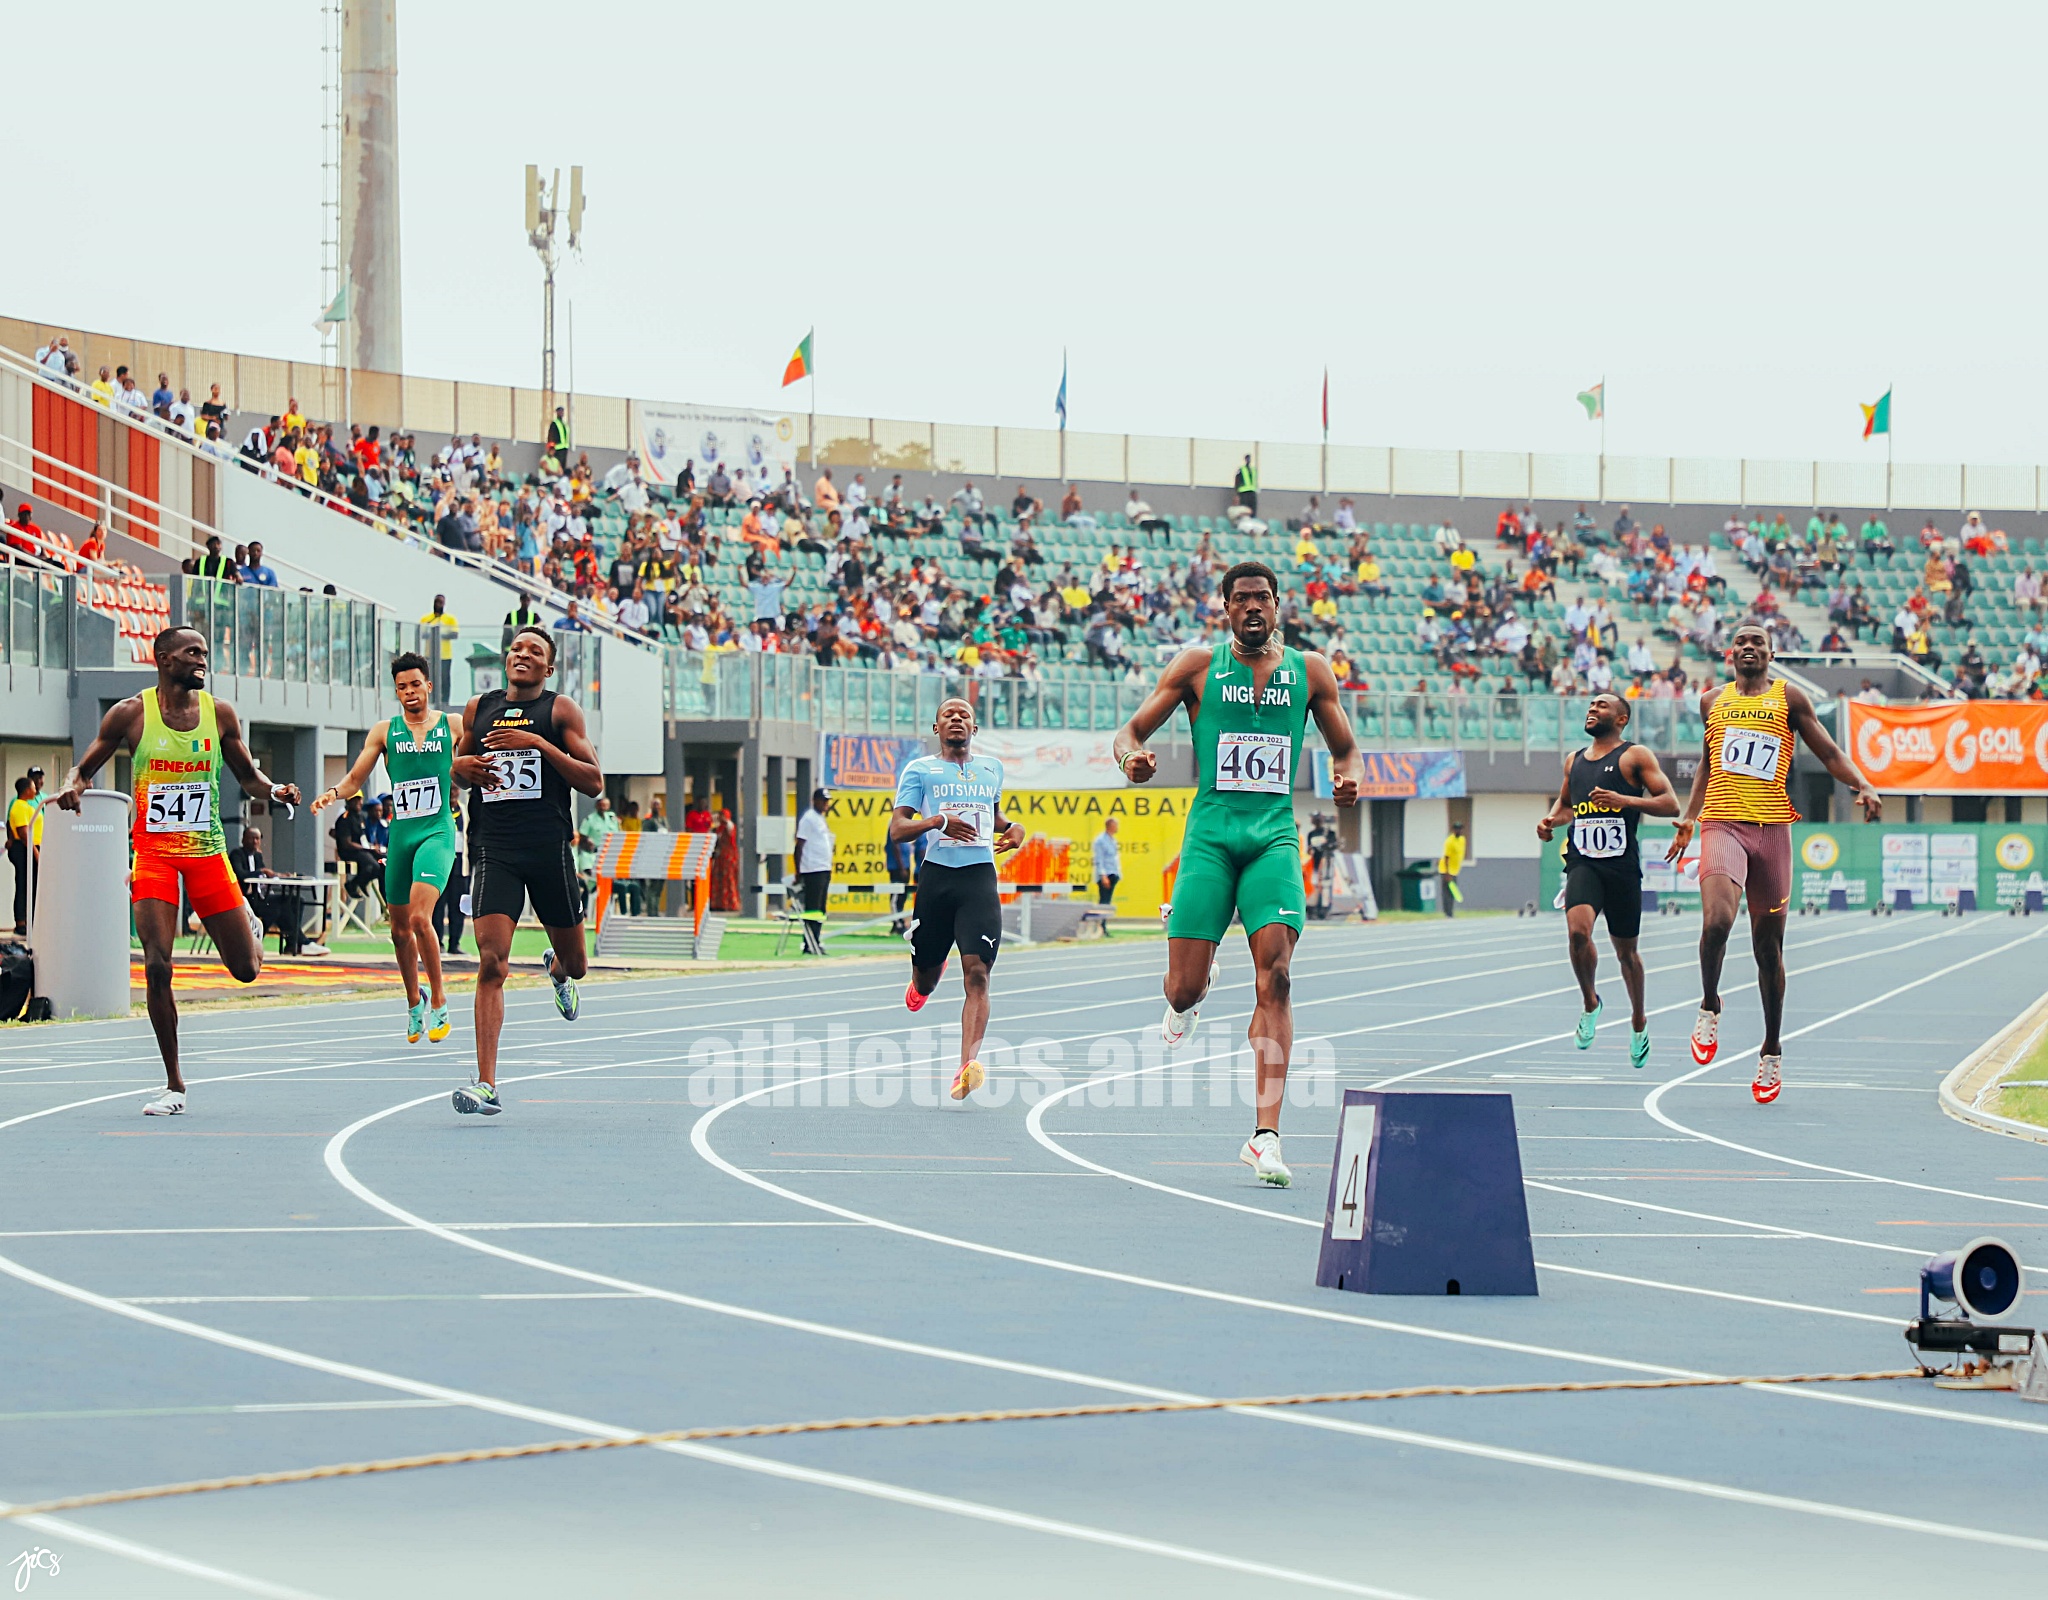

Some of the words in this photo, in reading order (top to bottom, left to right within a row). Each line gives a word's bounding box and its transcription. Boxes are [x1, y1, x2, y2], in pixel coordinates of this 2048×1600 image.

[1222, 685, 1291, 706] NIGERIA
[493, 719, 529, 727] ZAMBIA
[1722, 711, 1774, 720] UGANDA
[396, 741, 442, 753] NIGERIA
[1893, 727, 1934, 752] GOIL
[1979, 727, 2023, 752] GOIL
[834, 737, 898, 785] JEANS
[1221, 745, 1285, 781] 464
[1725, 738, 1776, 771] 617
[149, 792, 205, 824] 547
[397, 785, 435, 811] 477
[1006, 795, 1187, 816] AKWAABA!
[79, 824, 114, 832] MONDO
[1580, 826, 1622, 851] 103
[1342, 1154, 1358, 1228] 4
